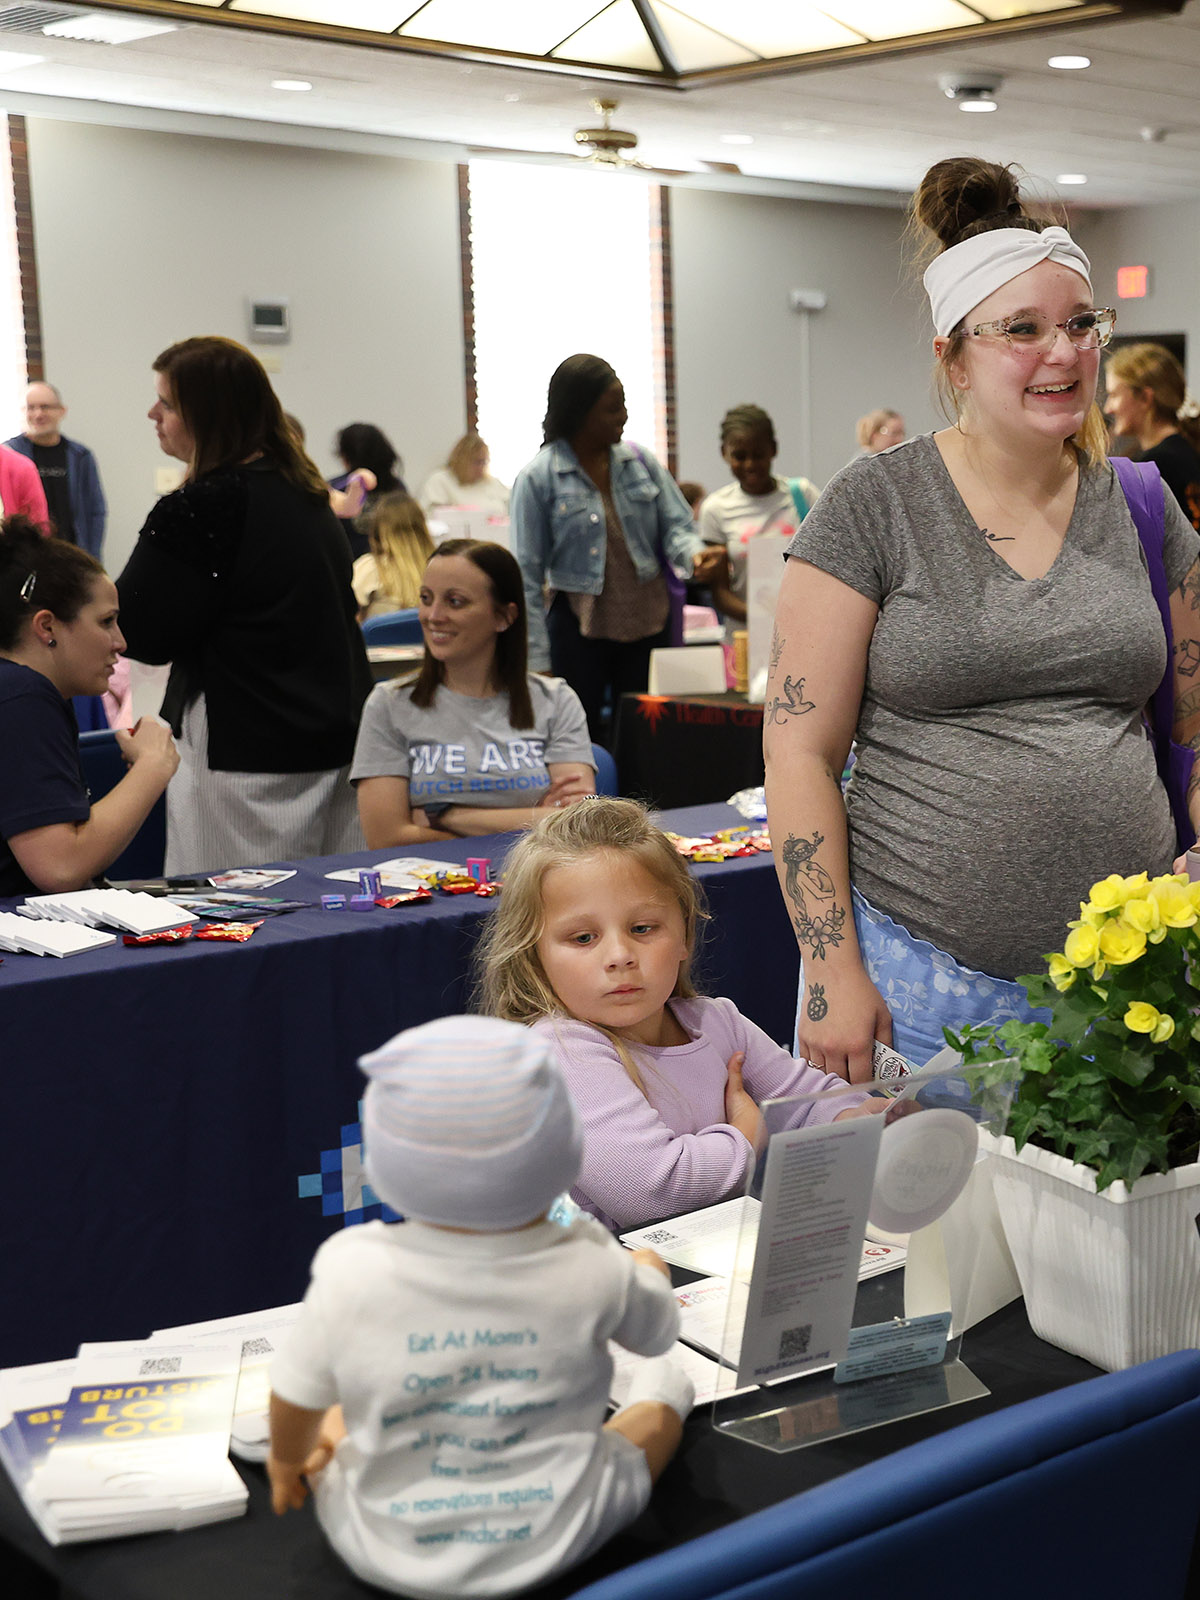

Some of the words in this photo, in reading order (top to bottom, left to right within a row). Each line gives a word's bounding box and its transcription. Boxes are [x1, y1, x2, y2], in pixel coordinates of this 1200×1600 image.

[730, 708, 763, 728] Car
[409, 743, 467, 775] WE
[480, 740, 546, 774] ARE
[470, 773, 551, 793] REGIONA
[407, 1332, 436, 1353] Eat
[442, 1330, 467, 1351] At
[472, 1326, 538, 1348] Mom's
[403, 1373, 454, 1393] Open
[488, 1360, 539, 1382] hours
[102, 1416, 185, 1439] DO
